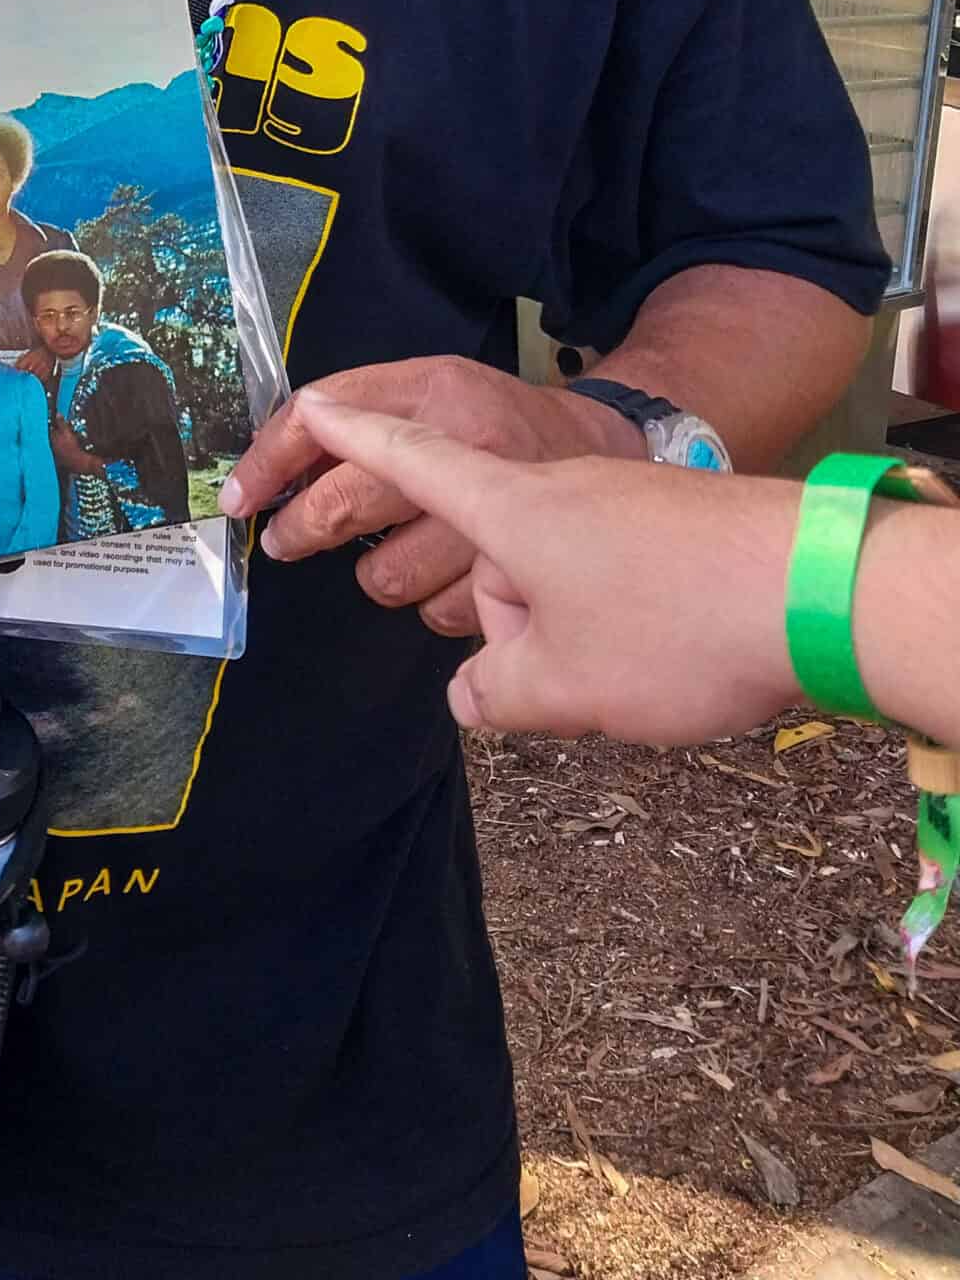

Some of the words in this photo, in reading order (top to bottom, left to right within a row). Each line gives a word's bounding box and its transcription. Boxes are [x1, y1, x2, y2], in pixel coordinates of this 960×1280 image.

[152, 533, 172, 541] rules
[100, 539, 131, 550] consent
[60, 549, 76, 557] and
[78, 551, 100, 559] video
[102, 553, 143, 564] recordings
[146, 556, 162, 564] that
[165, 558, 183, 567] may
[33, 559, 52, 567] used
[53, 560, 65, 568] for
[65, 562, 112, 573] promotional
